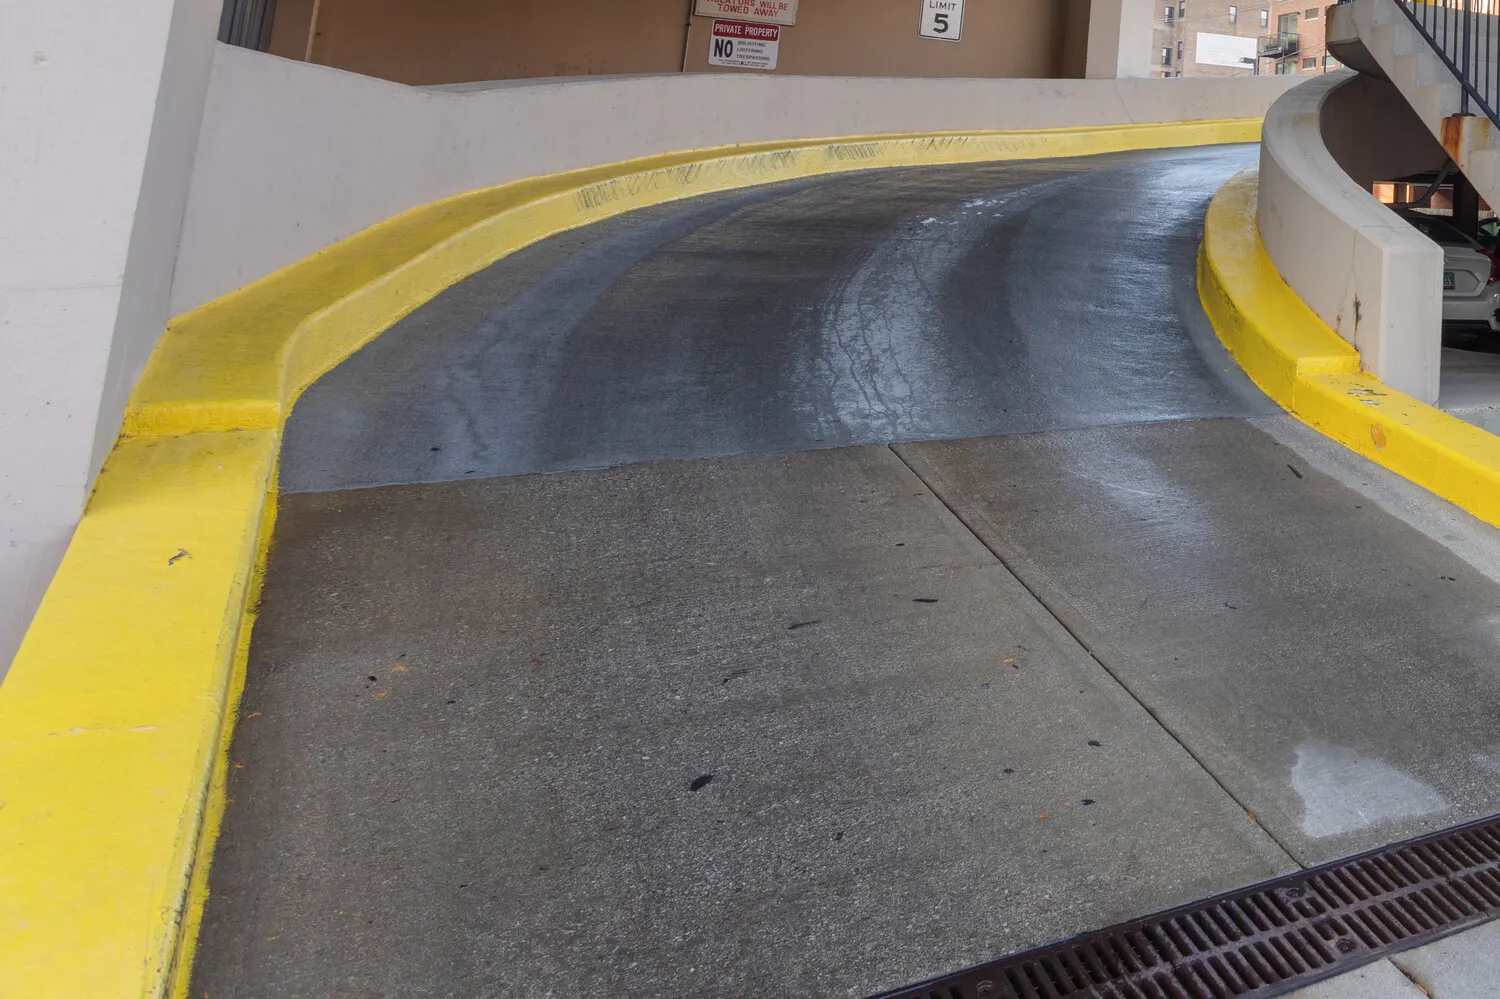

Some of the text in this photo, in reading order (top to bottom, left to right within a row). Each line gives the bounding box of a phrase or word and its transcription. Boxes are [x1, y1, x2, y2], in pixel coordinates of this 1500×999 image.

[718, 3, 779, 17] TOWED AWAY
[759, 0, 777, 10] WILL
[778, 2, 788, 11] BE
[929, 0, 957, 11] LIMIT
[714, 23, 778, 38] PRIVATE PROPERTY
[933, 13, 949, 34] 5
[713, 38, 734, 58] NO
